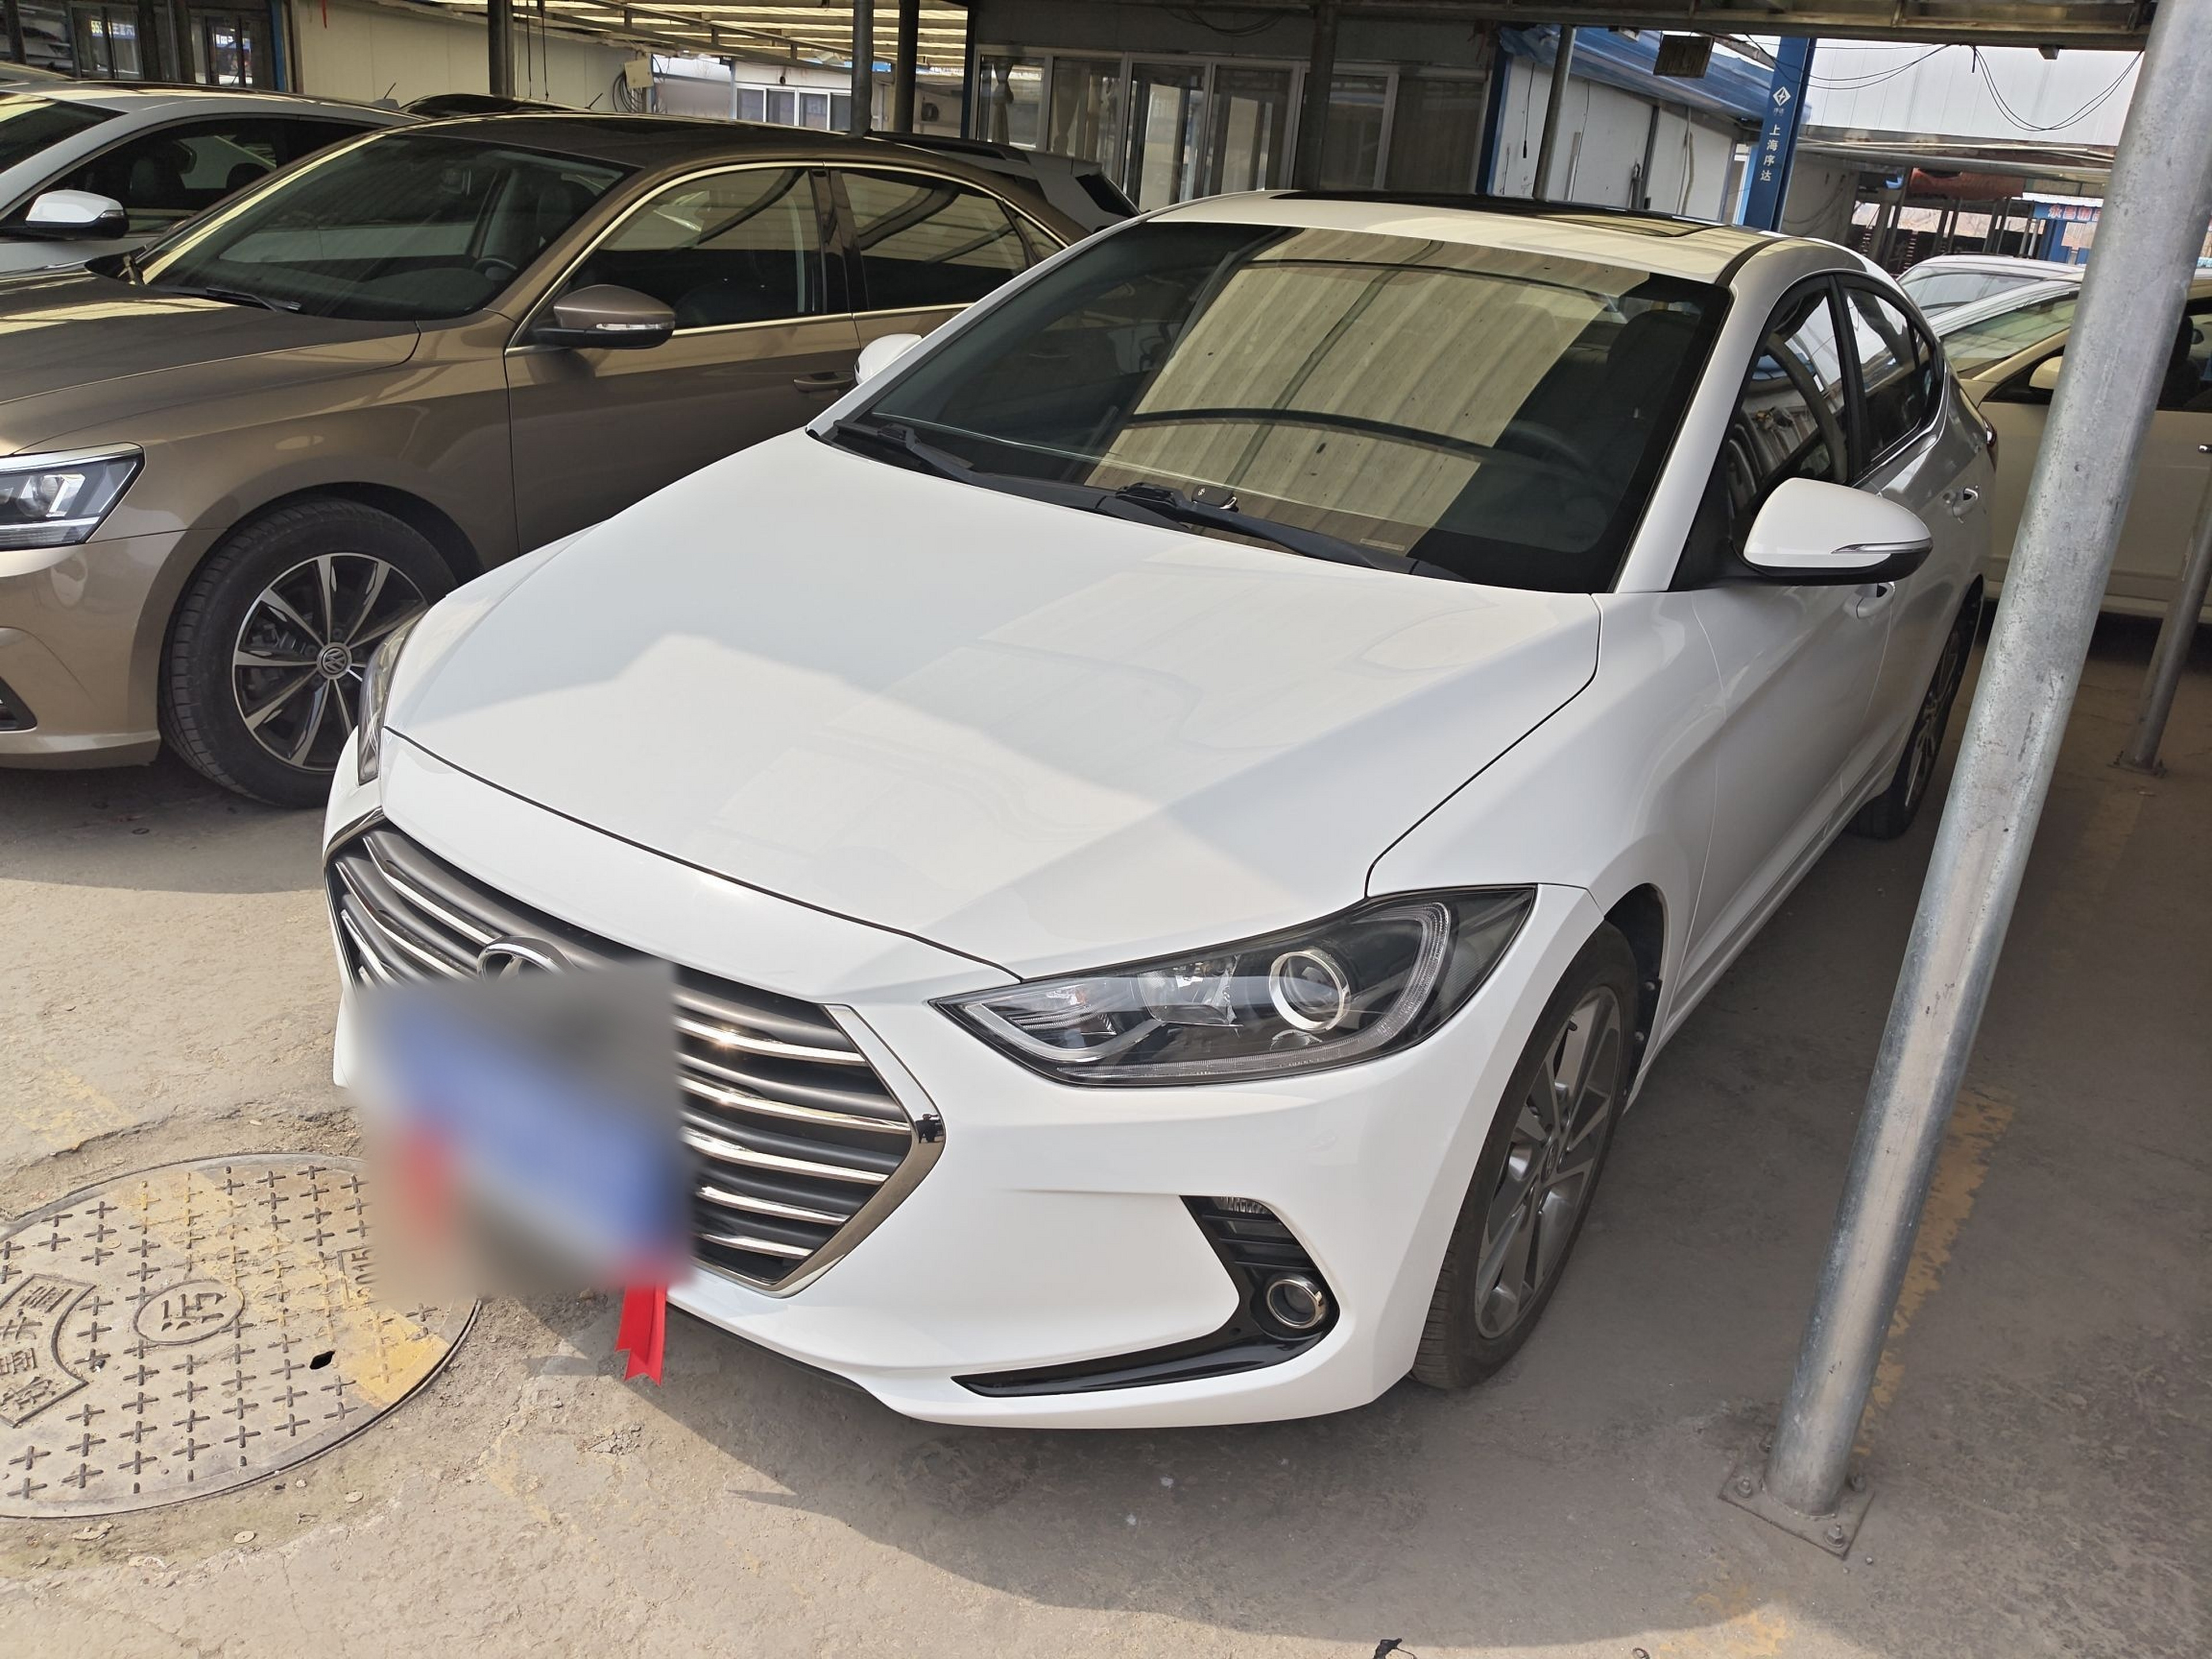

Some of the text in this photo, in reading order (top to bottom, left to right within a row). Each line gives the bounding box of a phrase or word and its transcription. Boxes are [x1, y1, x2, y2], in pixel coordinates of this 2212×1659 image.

[1760, 124, 1781, 181] 上海序达
[160, 1291, 228, 1332] 污
